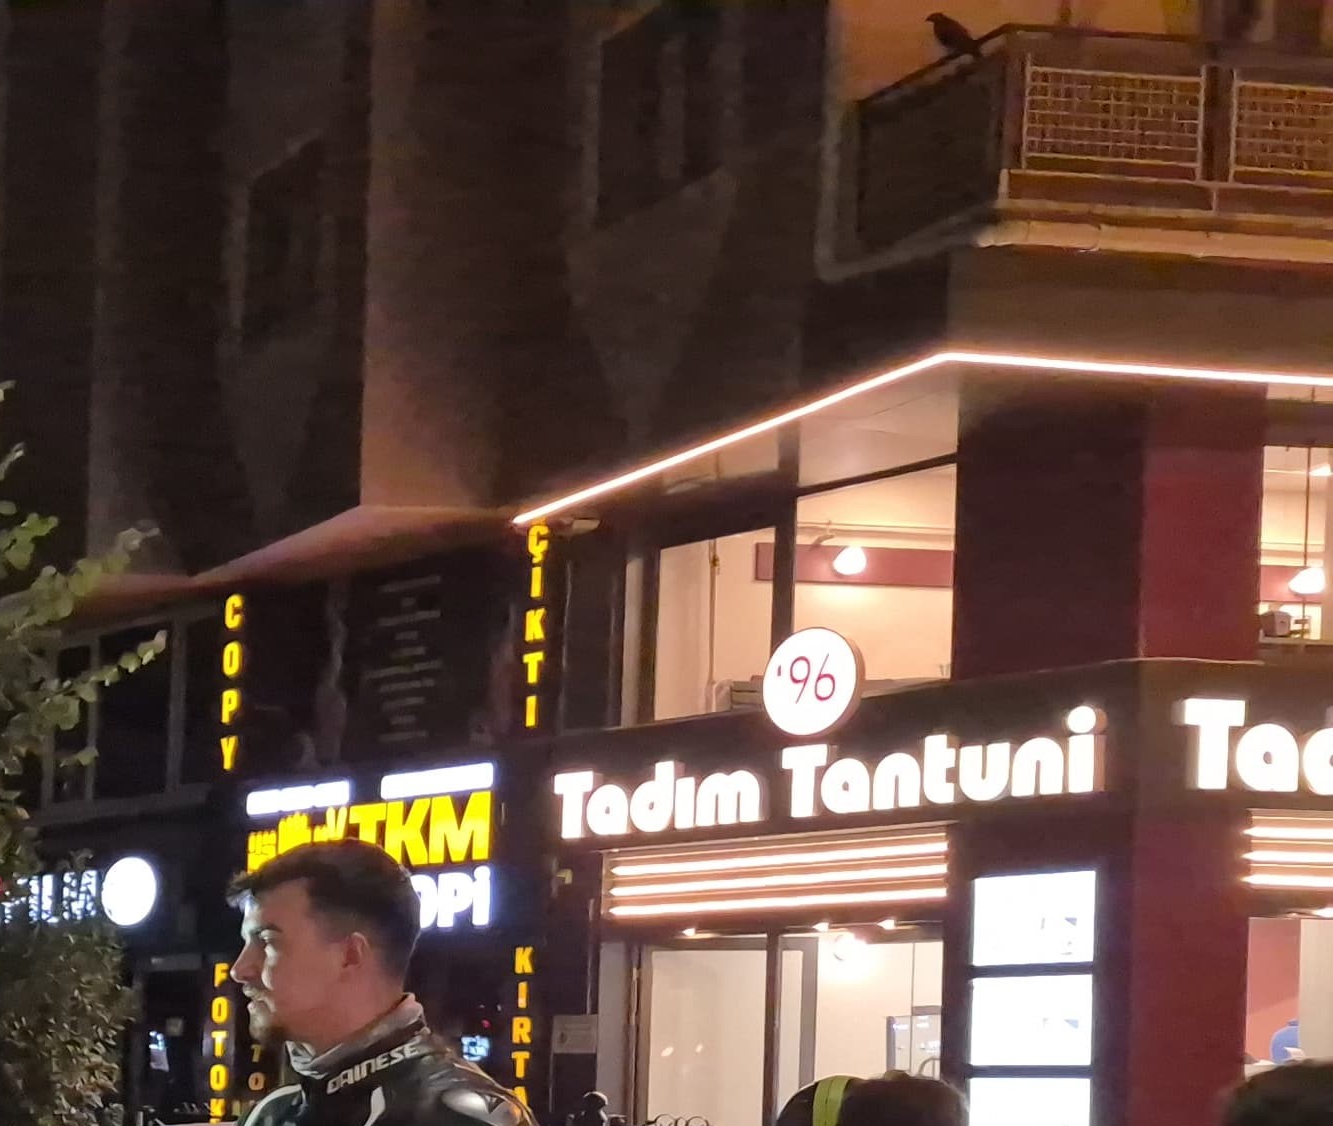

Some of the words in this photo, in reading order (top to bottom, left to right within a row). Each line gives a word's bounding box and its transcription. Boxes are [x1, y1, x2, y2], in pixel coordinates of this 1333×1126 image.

[220, 594, 243, 771] COPY
[522, 525, 549, 728] ÇIKTI
[781, 705, 1099, 818] Tantuni
